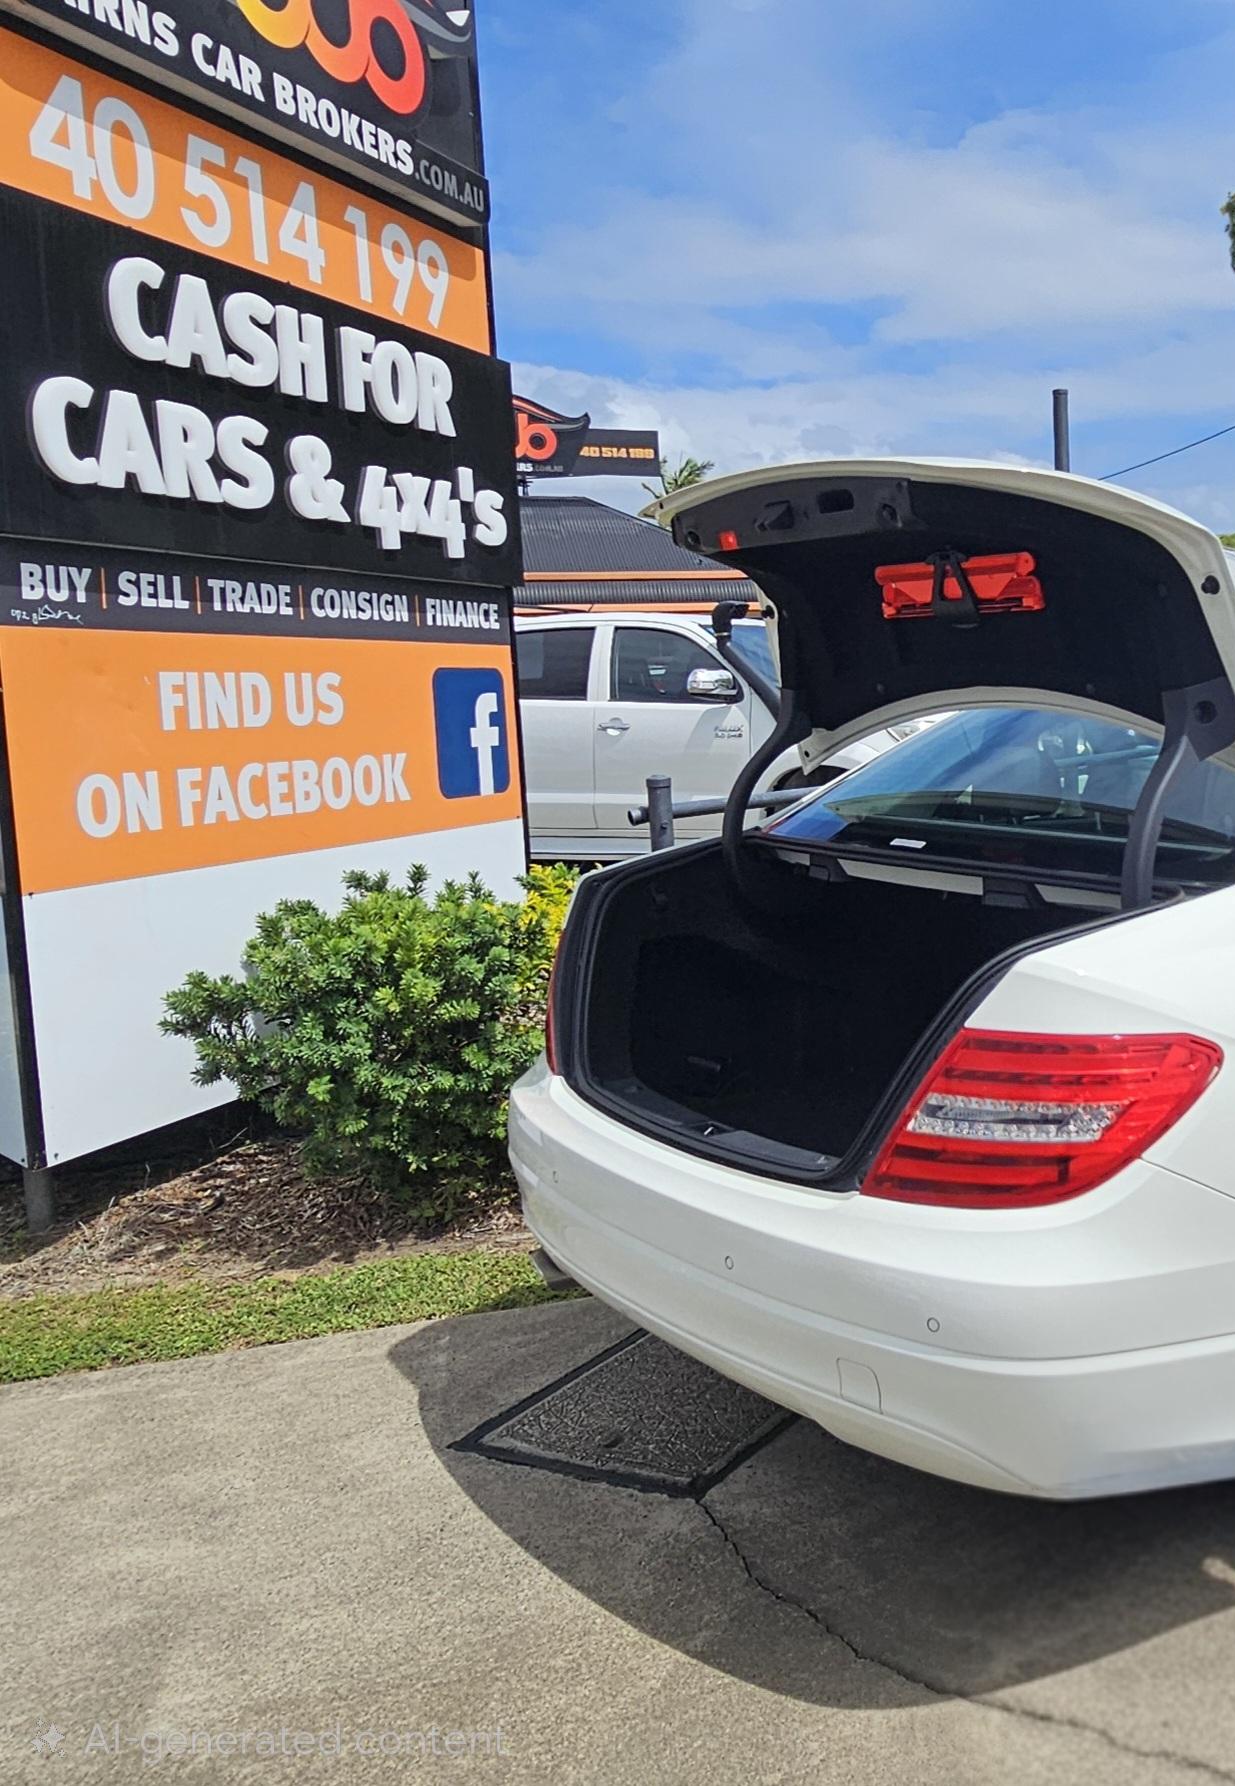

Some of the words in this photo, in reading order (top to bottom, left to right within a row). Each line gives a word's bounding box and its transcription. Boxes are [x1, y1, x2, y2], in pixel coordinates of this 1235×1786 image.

[191, 32, 265, 102] CAR
[29, 75, 155, 219] 40
[180, 134, 325, 284] 514
[344, 205, 449, 328] 199
[107, 257, 328, 402] CASH
[337, 326, 457, 437] FOR
[31, 376, 275, 510] CARS
[288, 435, 351, 522] &
[20, 562, 92, 604] BUY
[117, 571, 190, 610] SELL
[207, 578, 294, 617] TRADE
[310, 588, 409, 623] CONSIGN
[426, 598, 500, 631] FINANCE
[157, 671, 272, 732] FIND
[285, 671, 345, 726] US
[76, 770, 163, 838] ON
[176, 752, 411, 828] FACEBOOK
